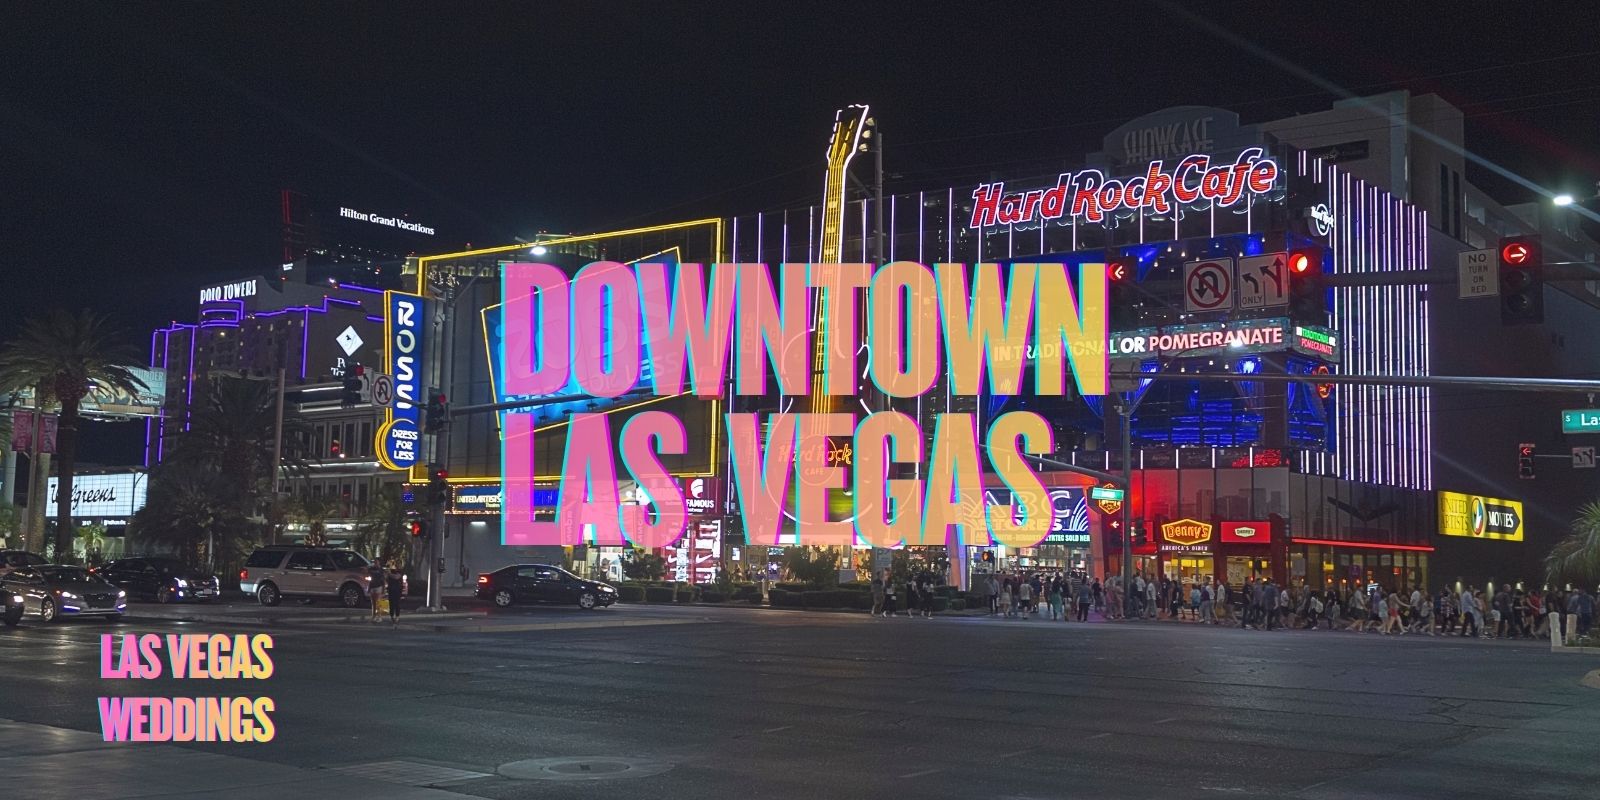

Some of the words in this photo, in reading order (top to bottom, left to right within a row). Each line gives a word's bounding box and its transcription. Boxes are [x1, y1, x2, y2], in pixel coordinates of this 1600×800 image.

[1123, 116, 1214, 164] SHOWCASE
[970, 172, 1071, 228] Hard
[1071, 160, 1172, 224] Rock
[1174, 148, 1278, 208] Cafe
[340, 206, 368, 222] Hilton
[369, 213, 396, 227] Grand
[396, 218, 435, 236] Vacations
[1468, 253, 1487, 263] NO
[1473, 275, 1484, 283] ON
[223, 279, 257, 300] TOWERS
[1470, 285, 1487, 294] RED
[1241, 294, 1264, 306] ONLY
[1120, 336, 1146, 354] OR
[1149, 327, 1283, 352] POMEGRANATE
[396, 300, 416, 410] ROSS
[391, 428, 418, 440] DRESS
[395, 440, 413, 450] FOR
[393, 450, 415, 461] LESS
[685, 498, 715, 508] FAMOUS
[1441, 497, 1468, 515] UNITED
[1441, 514, 1470, 531] ARTISTS
[1487, 510, 1514, 528] MOVIES
[1065, 534, 1080, 542] SOLD
[1166, 525, 1209, 539] Denny's
